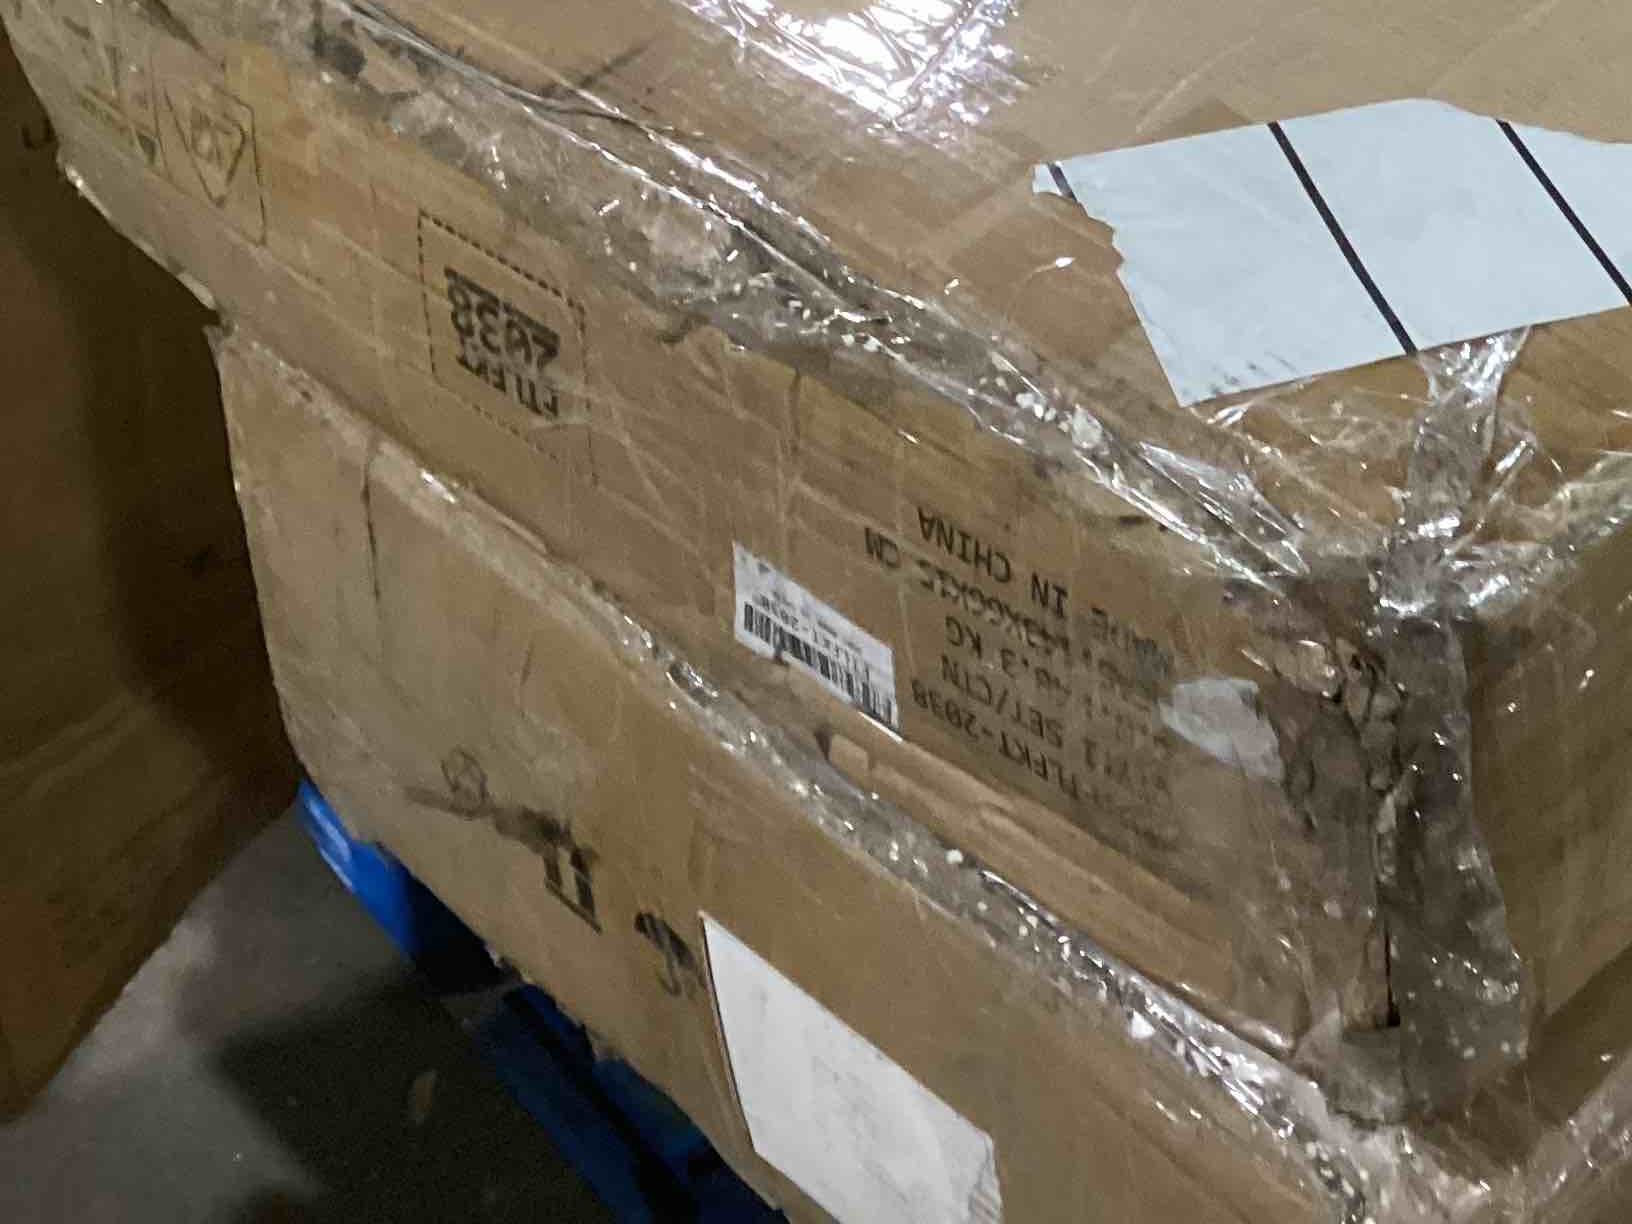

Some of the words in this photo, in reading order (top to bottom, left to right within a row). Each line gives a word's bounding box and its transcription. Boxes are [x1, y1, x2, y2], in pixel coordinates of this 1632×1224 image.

[447, 282, 558, 370] 2038
[916, 508, 1012, 584] CHINA
[1030, 573, 1068, 619] IN
[942, 656, 1065, 747] SET/CTN
